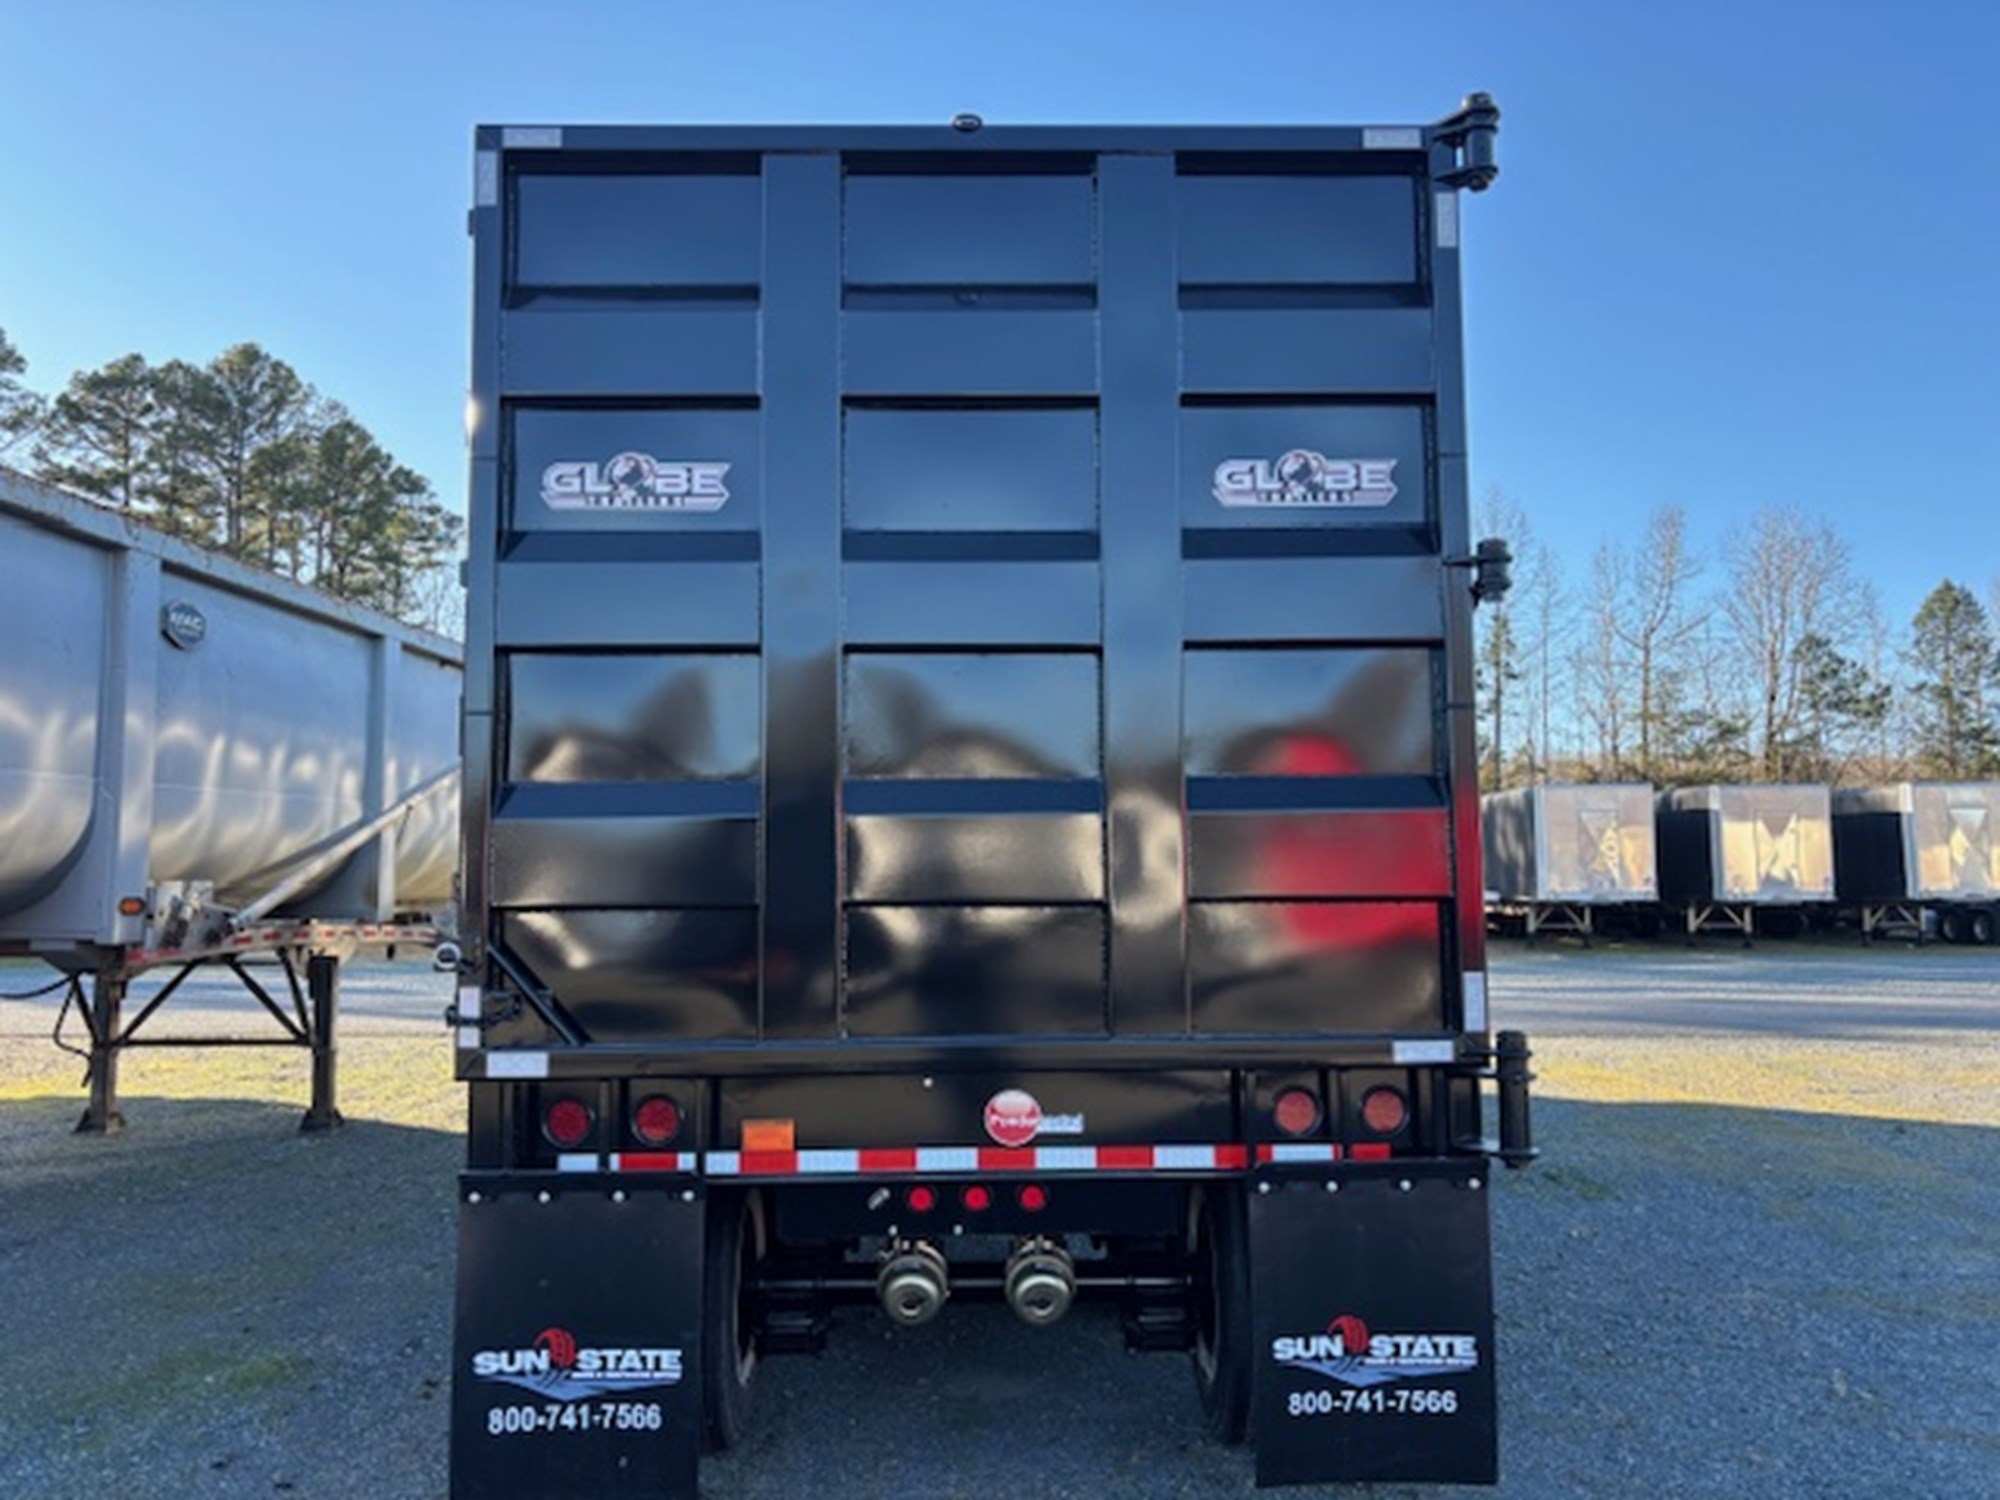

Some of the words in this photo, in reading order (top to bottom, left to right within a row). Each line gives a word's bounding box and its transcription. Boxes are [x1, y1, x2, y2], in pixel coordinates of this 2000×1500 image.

[542, 452, 731, 494] GLOBE
[1214, 450, 1397, 490] GLOBE
[473, 1350, 549, 1376] SUN
[576, 1348, 682, 1372] STATE
[1272, 1336, 1343, 1360] SUN
[1369, 1335, 1477, 1358] STATE
[1288, 1390, 1457, 1416] 800-741-7566
[488, 1404, 662, 1435] 800-741-7566
